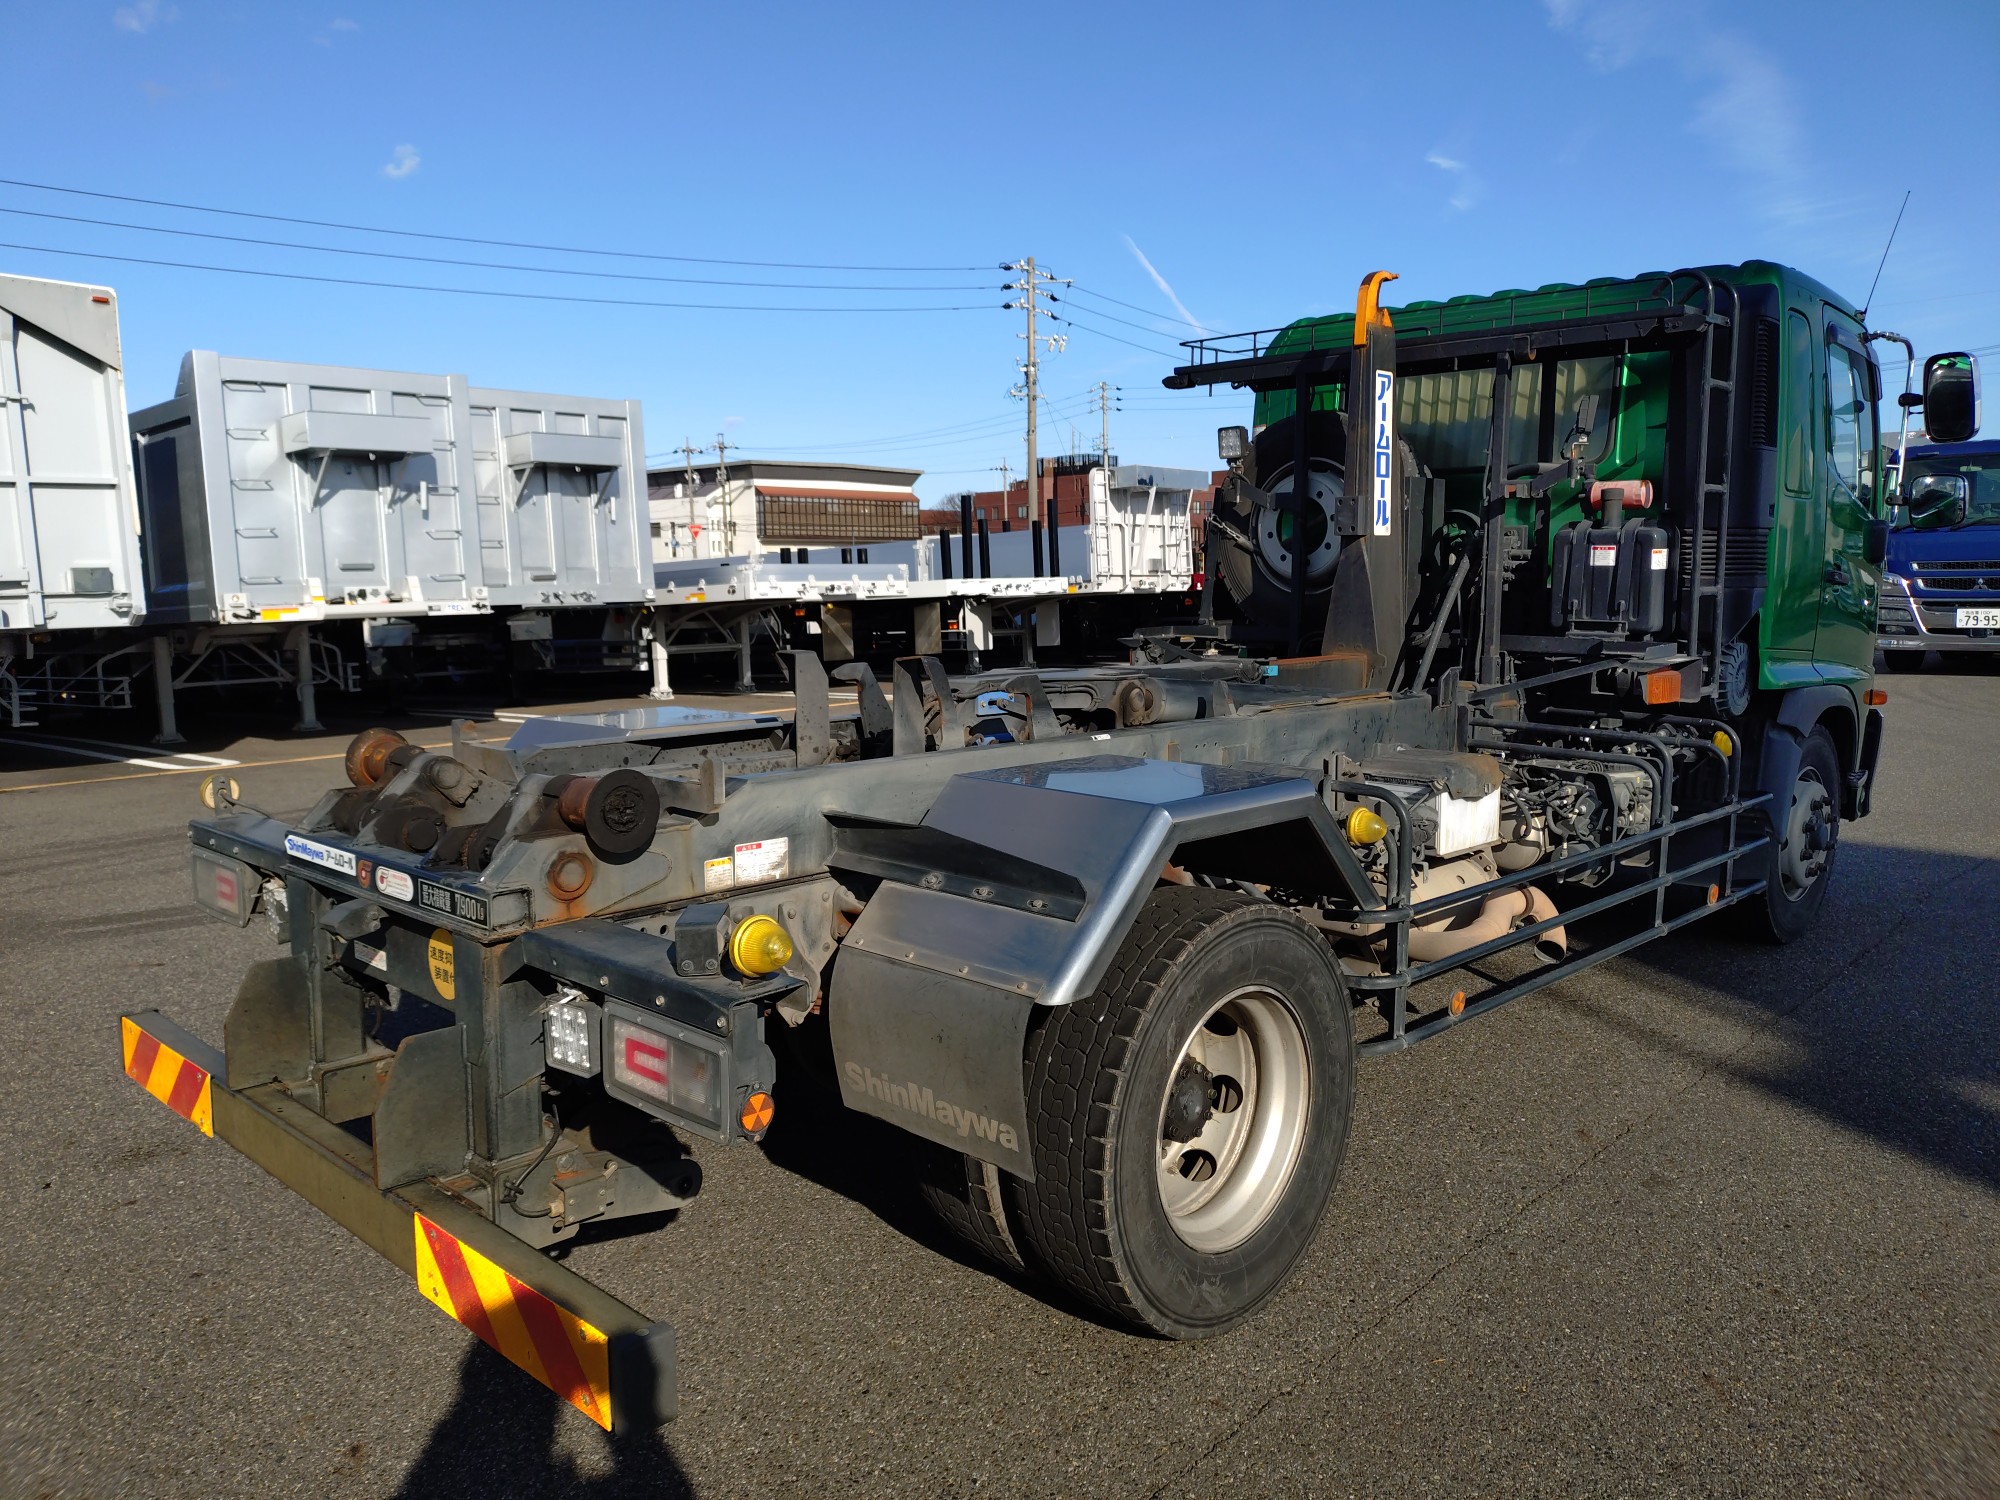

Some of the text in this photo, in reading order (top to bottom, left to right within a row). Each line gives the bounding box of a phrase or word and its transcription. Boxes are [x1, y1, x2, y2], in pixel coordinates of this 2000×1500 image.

[1375, 372, 1392, 527] アームロール
[1964, 615, 1999, 626] 79-95
[287, 838, 325, 860] ShinMaywa
[422, 884, 452, 912] 最大積載量
[843, 1060, 1020, 1153] ShinMaywa
